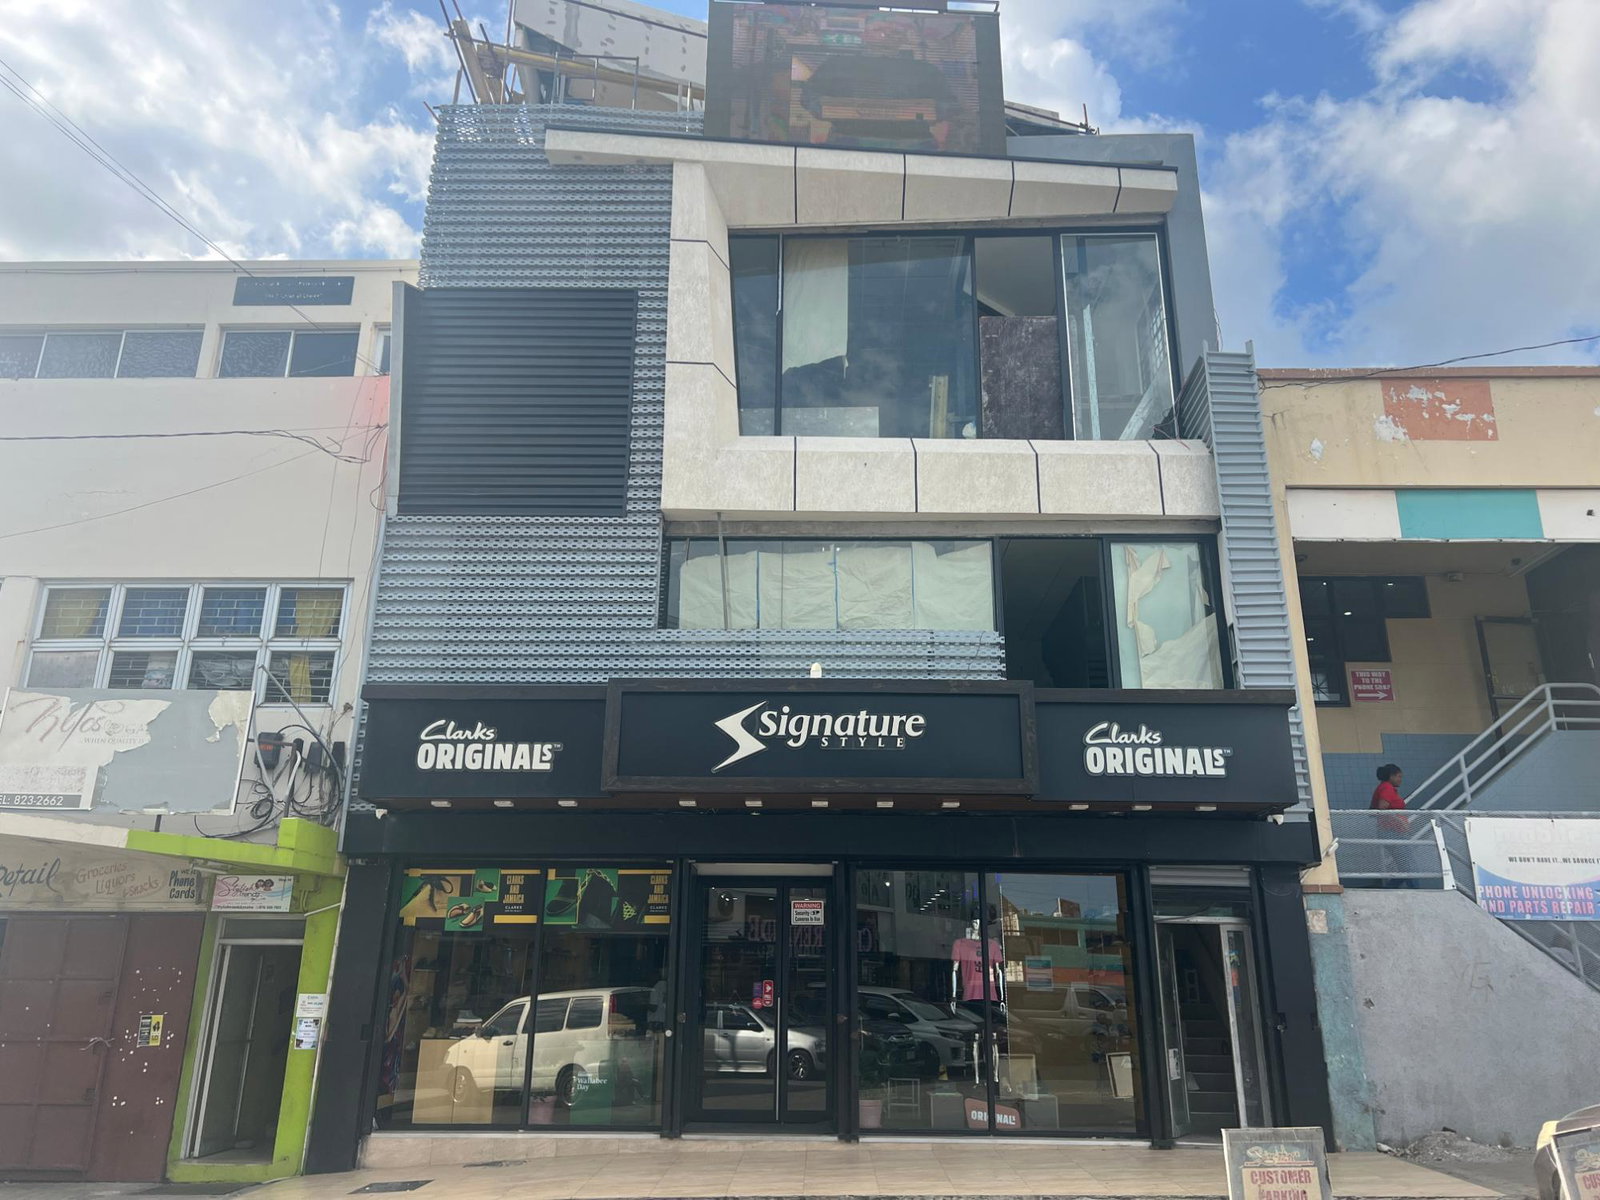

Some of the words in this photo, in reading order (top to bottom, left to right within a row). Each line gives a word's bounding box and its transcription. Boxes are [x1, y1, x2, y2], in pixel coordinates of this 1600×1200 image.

[420, 719, 496, 741] Clarks
[758, 705, 926, 748] Signature
[1085, 722, 1162, 744] Clarks
[820, 736, 905, 748] STYLE
[417, 743, 553, 770] ORIGINALS
[1086, 747, 1226, 775] ORIGINALS
[13, 795, 64, 806] 823-2662
[169, 869, 195, 887] Phone
[169, 886, 195, 899] Cards
[1480, 885, 1519, 899] PHONE
[1522, 886, 1594, 900] UNLOCKING
[1480, 900, 1506, 913] AND
[1510, 900, 1549, 914] PARTS
[1552, 901, 1595, 914] REPAIR
[577, 1084, 589, 1092] Day
[971, 1110, 1016, 1126] ORINALS
[1250, 1168, 1312, 1185] CUSTOMER
